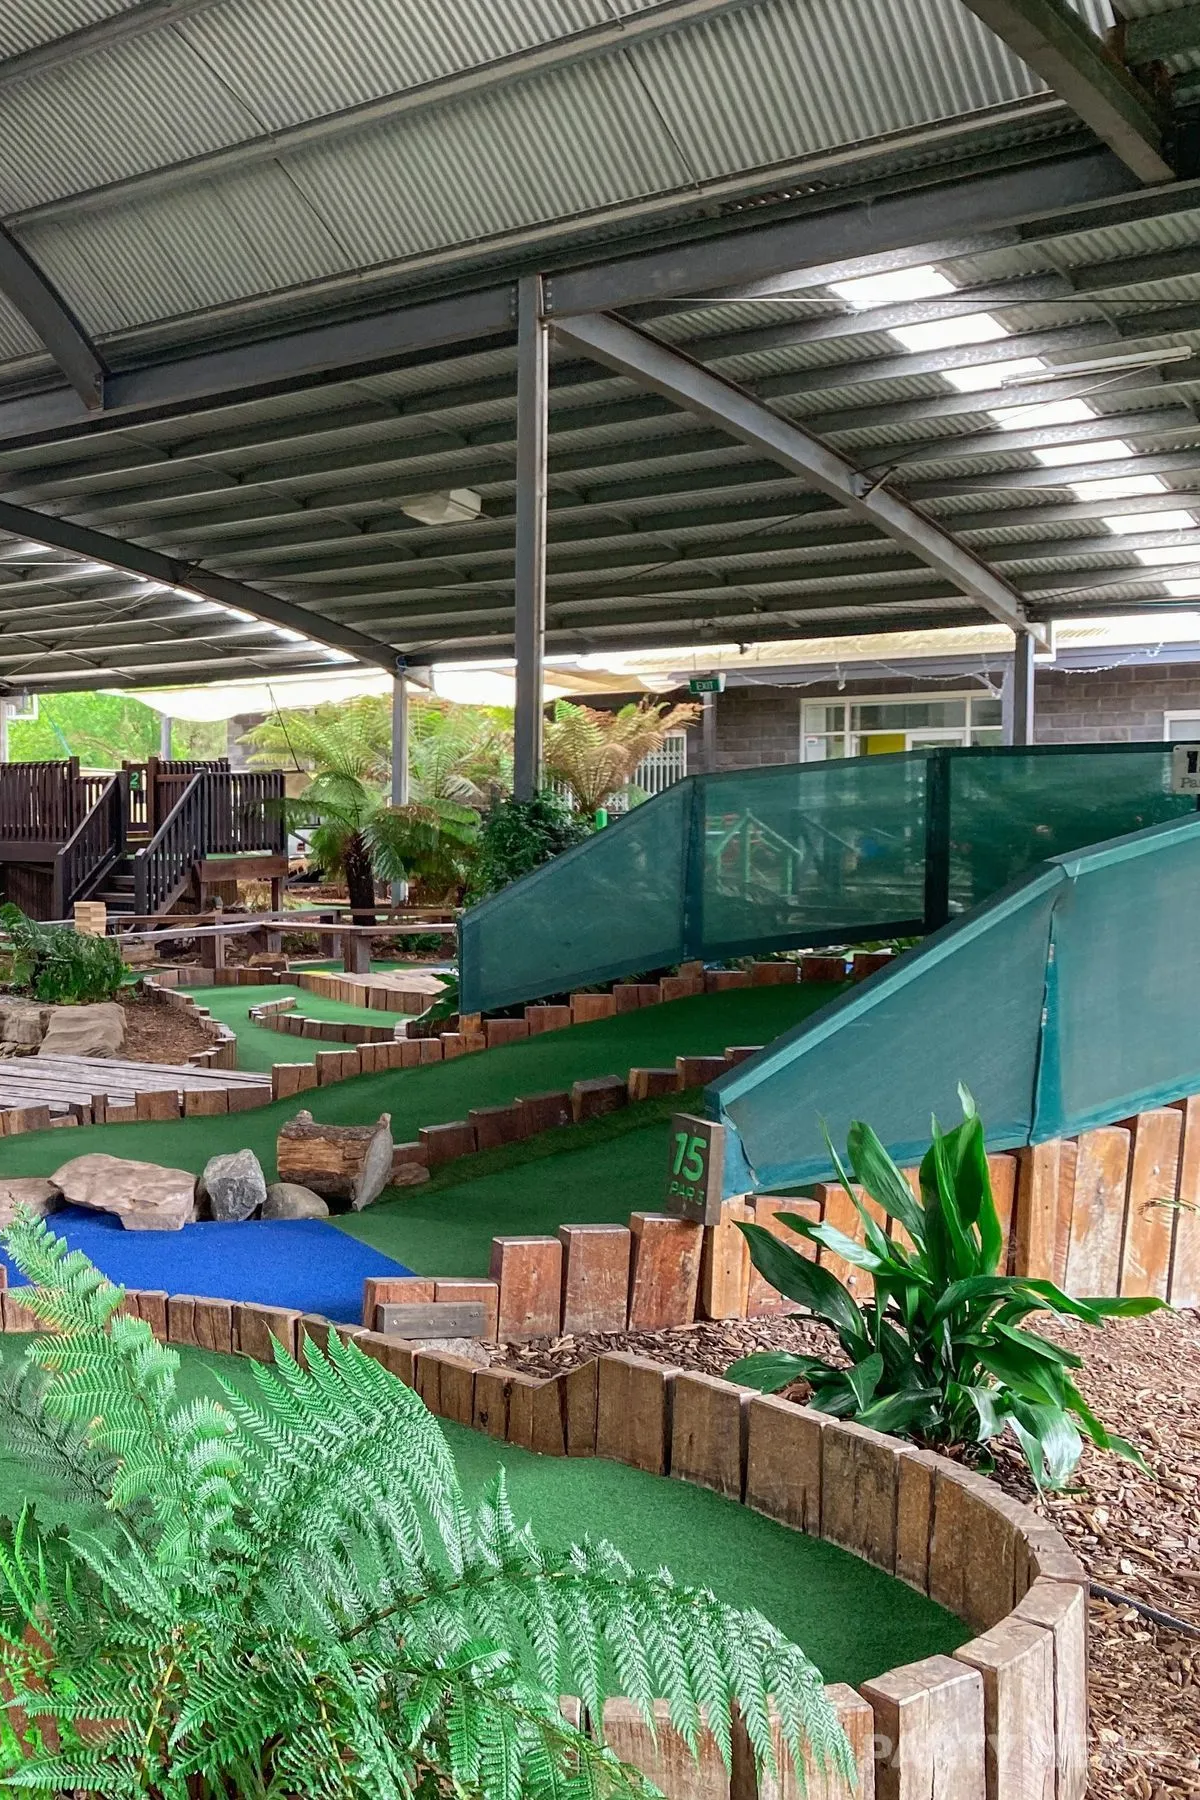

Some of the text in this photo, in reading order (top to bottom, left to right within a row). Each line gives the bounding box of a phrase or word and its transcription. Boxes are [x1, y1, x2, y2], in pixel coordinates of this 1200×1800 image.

[696, 681, 714, 690] EXIT
[672, 1132, 707, 1181] 15
[669, 1181, 695, 1202] PAR
